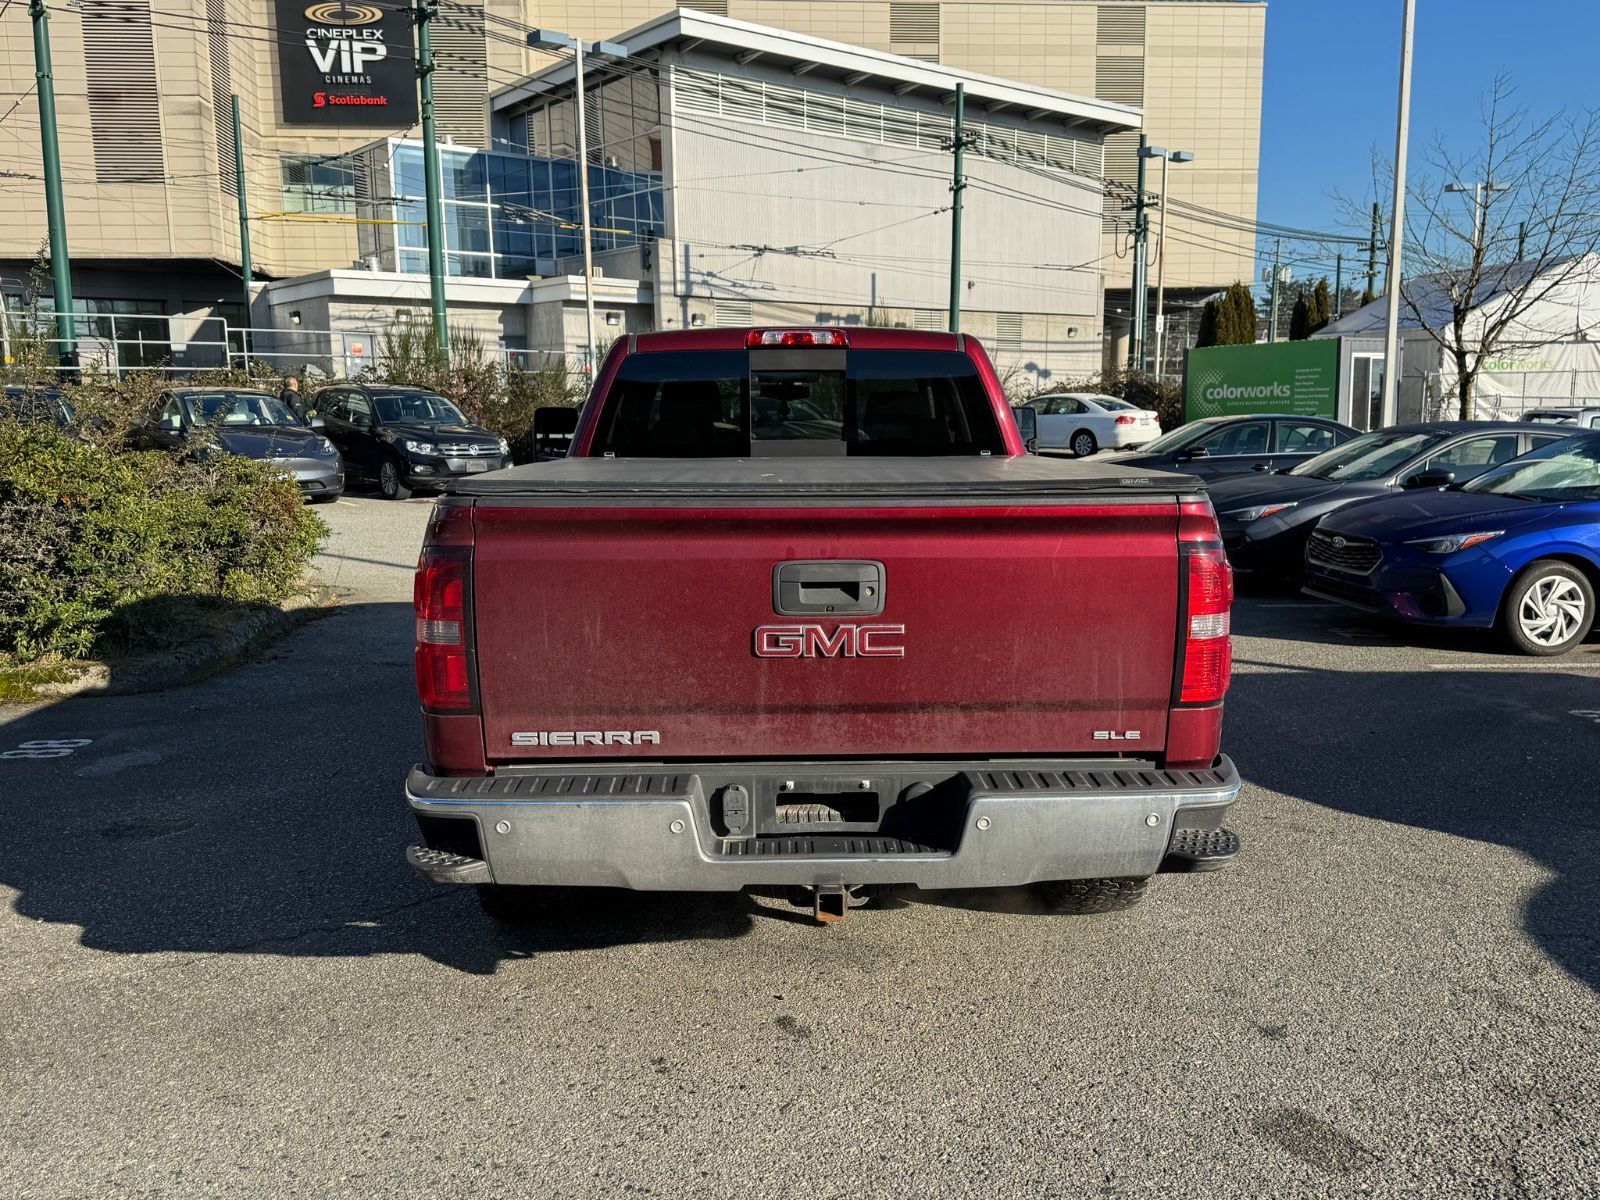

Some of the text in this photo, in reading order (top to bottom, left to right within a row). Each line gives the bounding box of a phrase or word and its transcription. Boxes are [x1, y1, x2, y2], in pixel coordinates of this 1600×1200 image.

[306, 28, 384, 40] CINEPLEX
[305, 39, 387, 73] VIP
[325, 75, 372, 84] CINEMAS
[329, 95, 387, 105] Scotiabank
[1206, 381, 1291, 399] colorworks
[755, 624, 905, 657] GMC
[511, 730, 661, 746] SIERRA
[1093, 730, 1141, 740] SLE
